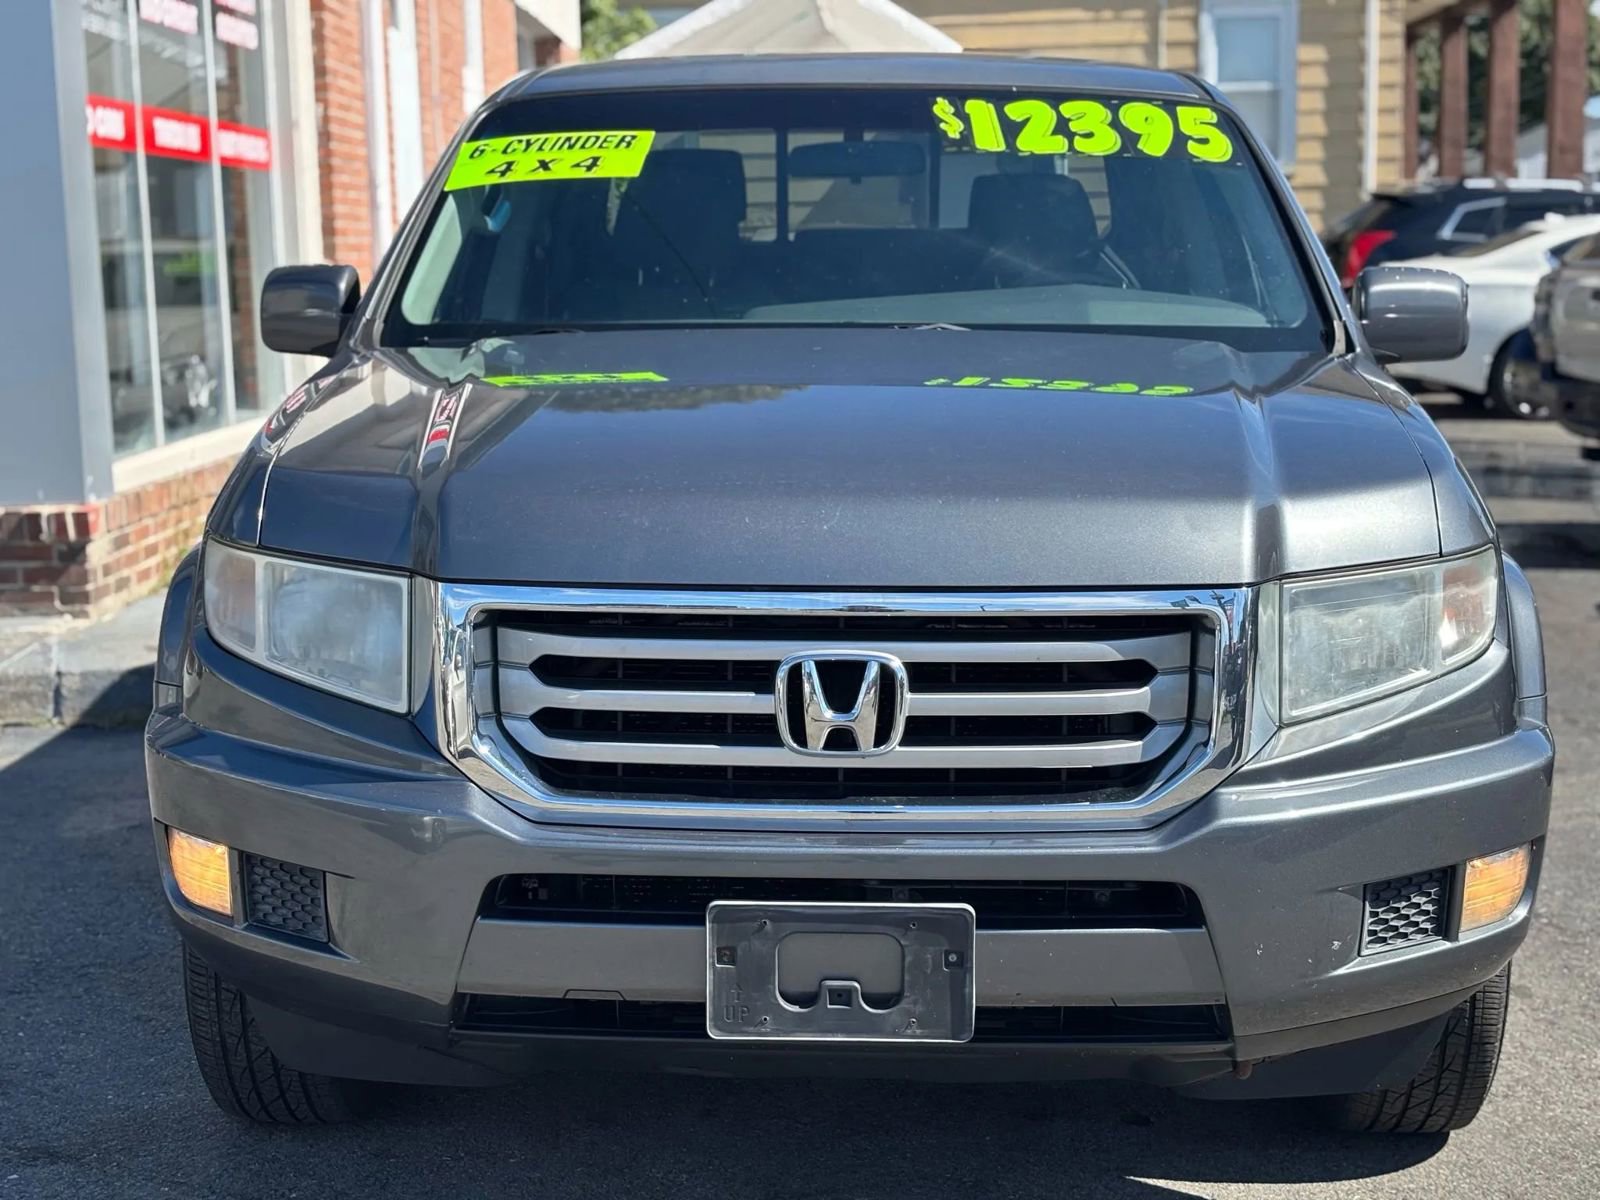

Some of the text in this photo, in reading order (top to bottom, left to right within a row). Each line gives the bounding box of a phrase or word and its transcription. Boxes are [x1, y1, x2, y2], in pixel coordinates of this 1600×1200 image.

[933, 97, 1233, 162] $12395
[468, 134, 638, 160] 6-CYLINDER
[723, 1006, 750, 1023] UP
